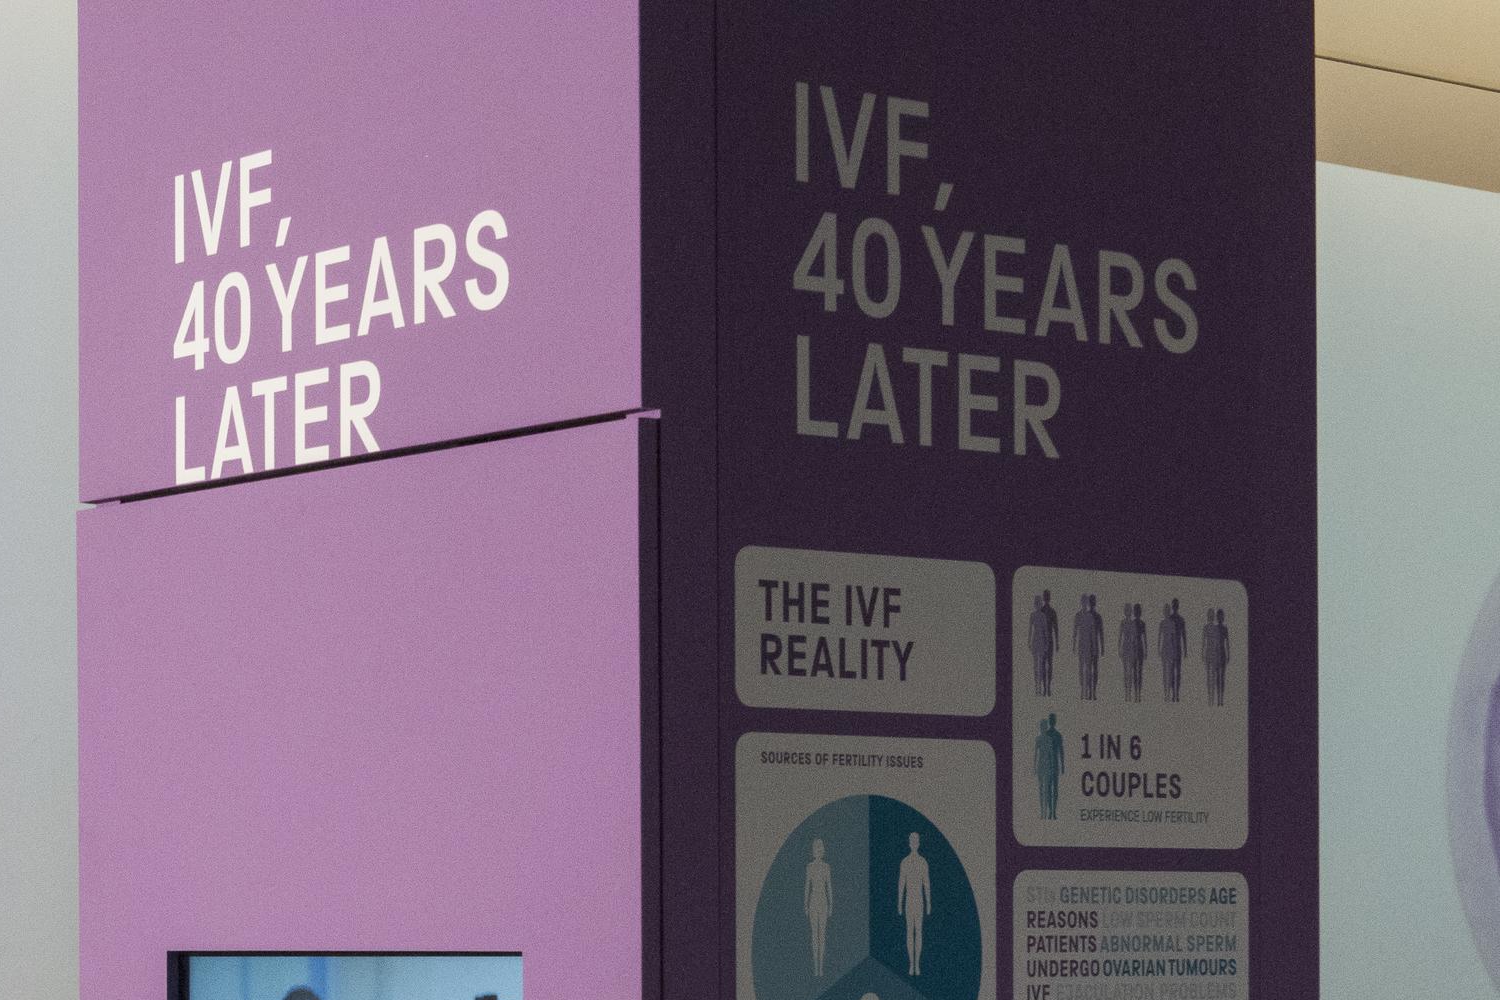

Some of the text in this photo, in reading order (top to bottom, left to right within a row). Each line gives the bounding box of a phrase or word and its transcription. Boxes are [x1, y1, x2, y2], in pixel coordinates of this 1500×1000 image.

[796, 81, 954, 211] IVF,
[174, 150, 291, 264] IVF,
[174, 210, 509, 370] 40 YEARS
[793, 212, 1199, 354] 40 YEARS
[796, 334, 1061, 459] LATER
[175, 360, 381, 485] LATER
[759, 580, 902, 628] THE IVF
[760, 634, 914, 681] REALITY
[760, 751, 924, 768] SOURCES OF FERTILITY ISSUES
[1080, 734, 1142, 760] 1 IN 6
[1080, 772, 1182, 798] COUPLES
[1080, 809, 1210, 824] EXPERIENCE LOW FERTILITY
[1060, 886, 1122, 904] GENETIC
[1125, 887, 1206, 904] DISORDERS
[1209, 887, 1236, 905] AGE
[1027, 911, 1098, 929] REASONS
[1027, 934, 1236, 953] PATIENTS ABNORMAL SPERM
[1027, 959, 1236, 977] UNDERGO OVARIAN TUMOURS
